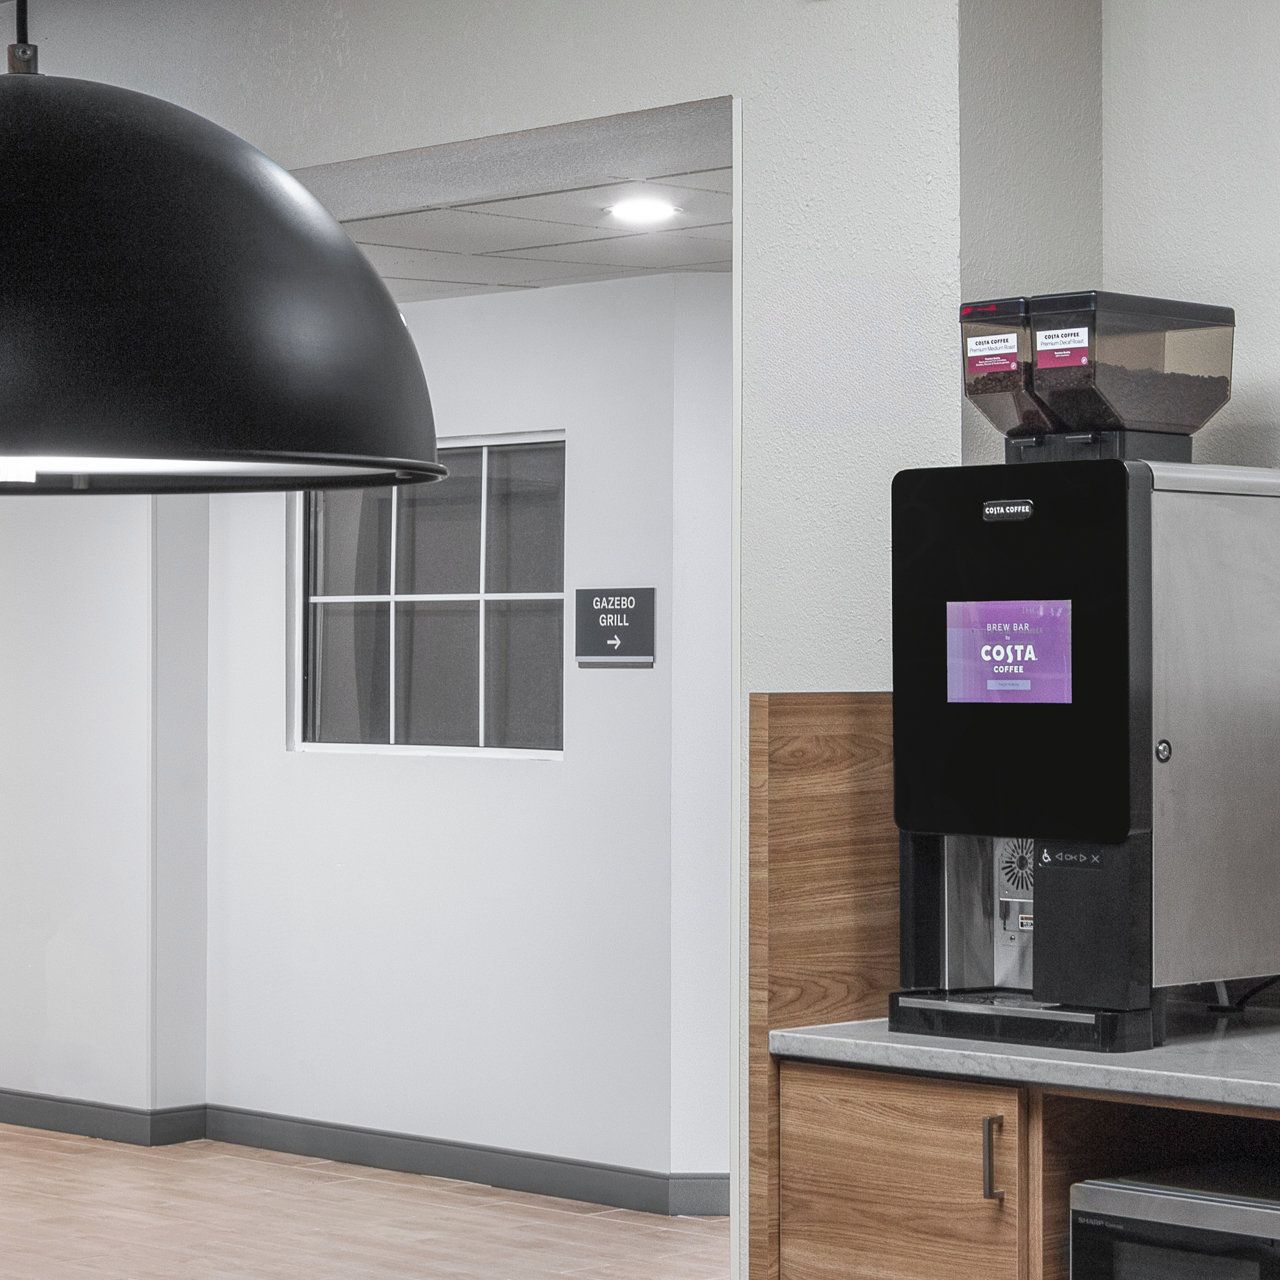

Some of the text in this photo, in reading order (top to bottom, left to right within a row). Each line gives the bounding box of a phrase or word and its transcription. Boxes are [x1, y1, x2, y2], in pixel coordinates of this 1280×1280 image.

[985, 505, 1030, 515] COSTA COFFEE
[592, 596, 636, 609] GAZEBO
[599, 614, 630, 627] GRILL
[986, 622, 1030, 631] BREW BAR
[981, 644, 1037, 664] COSTA
[993, 665, 1024, 674] COFFEE
